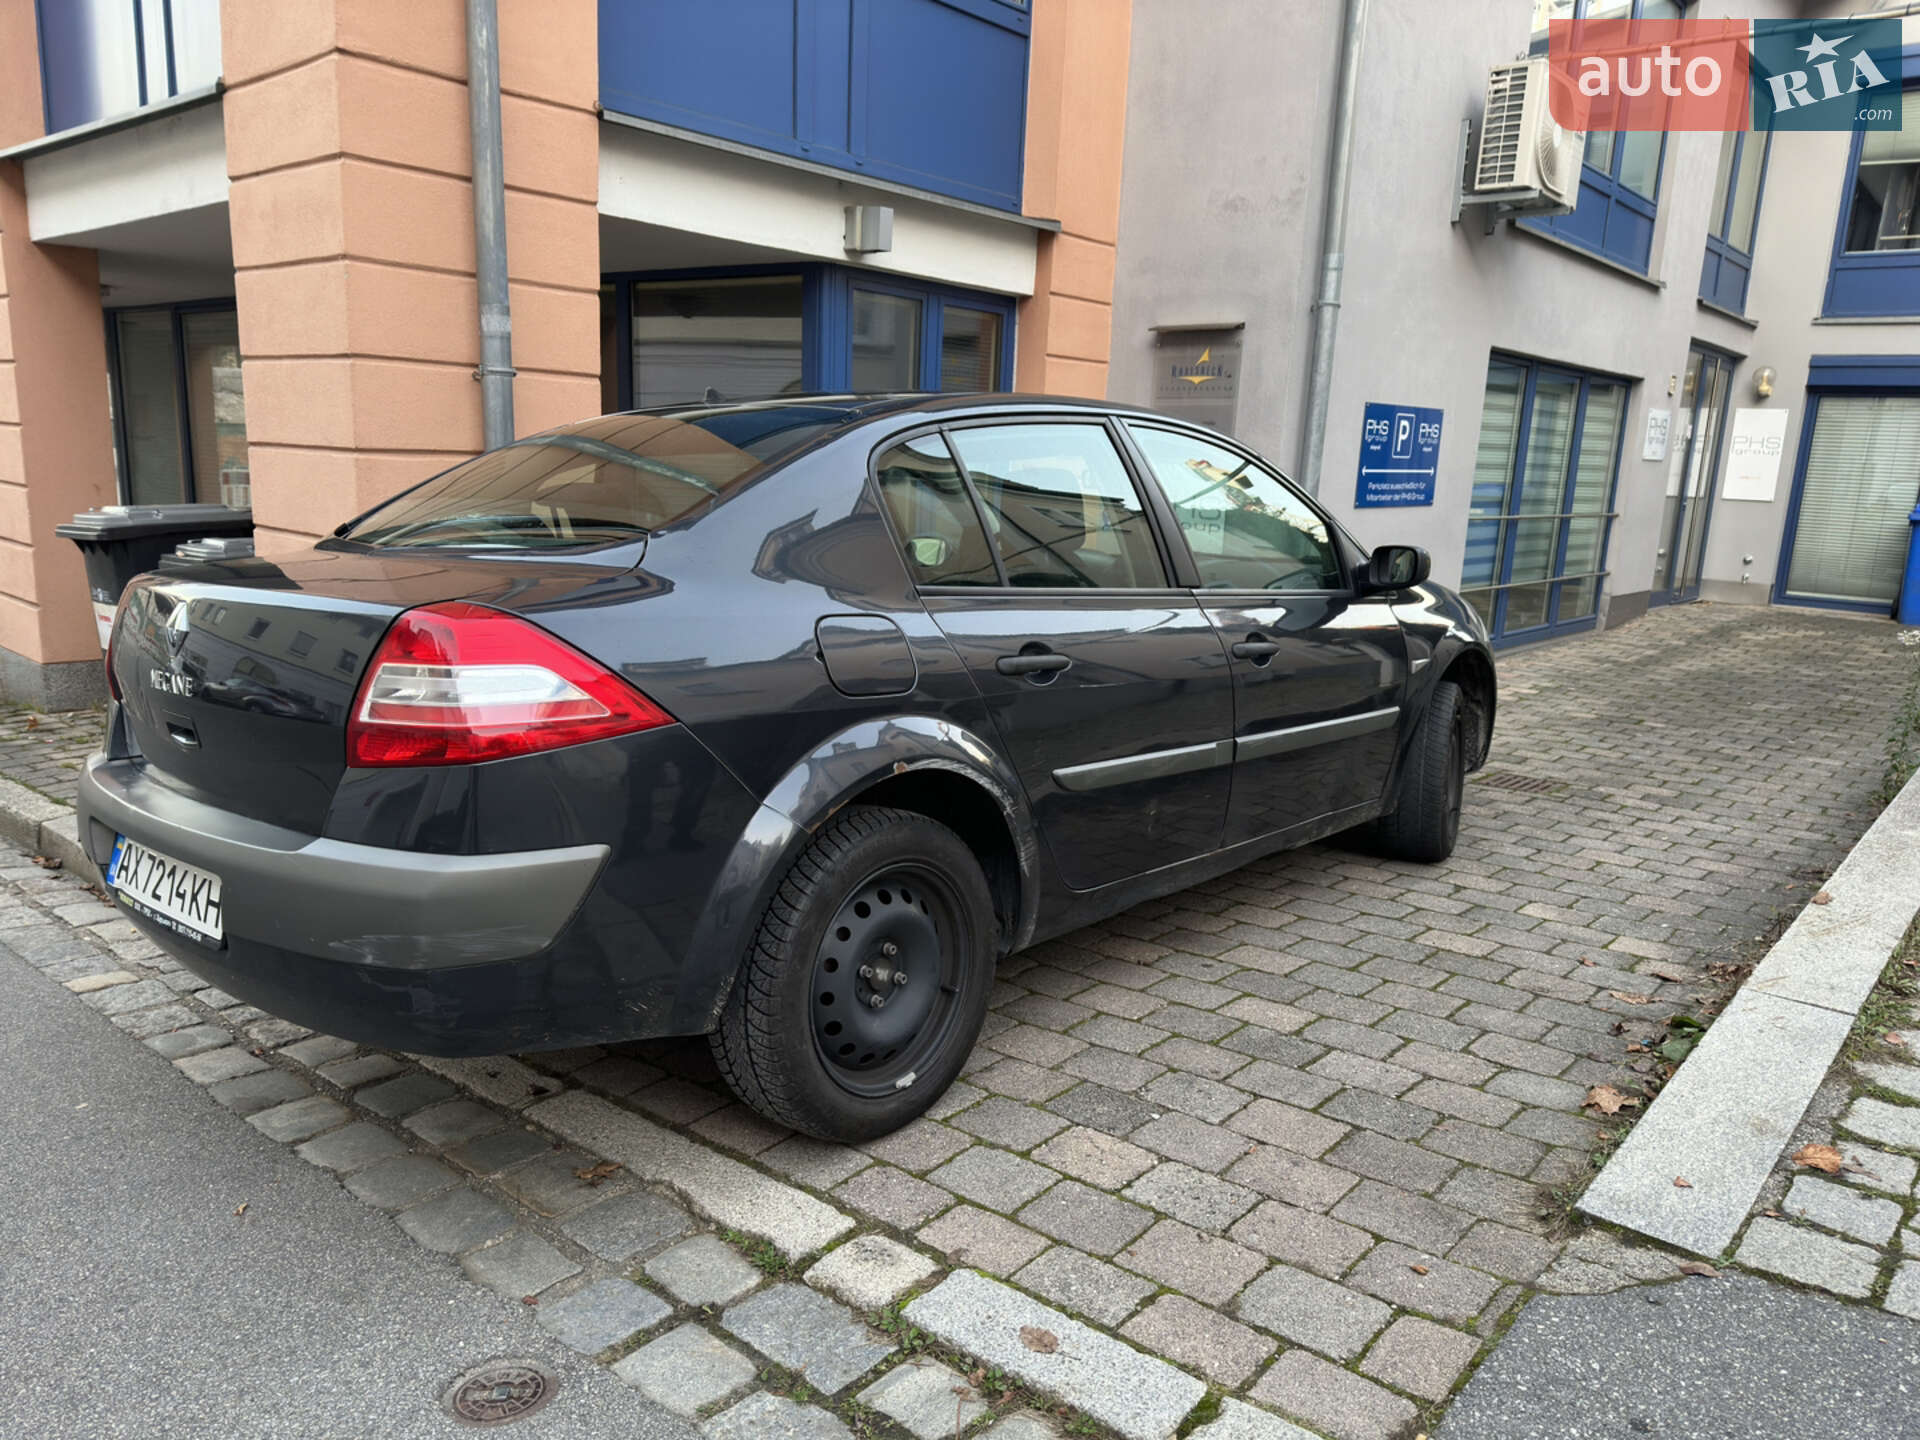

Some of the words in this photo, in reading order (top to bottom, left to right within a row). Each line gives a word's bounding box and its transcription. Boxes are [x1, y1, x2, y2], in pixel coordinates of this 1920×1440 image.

[1365, 419, 1390, 441] PHS
[1397, 419, 1411, 452] P
[1418, 423, 1440, 443] PHS
[1731, 435, 1783, 450] PHS
